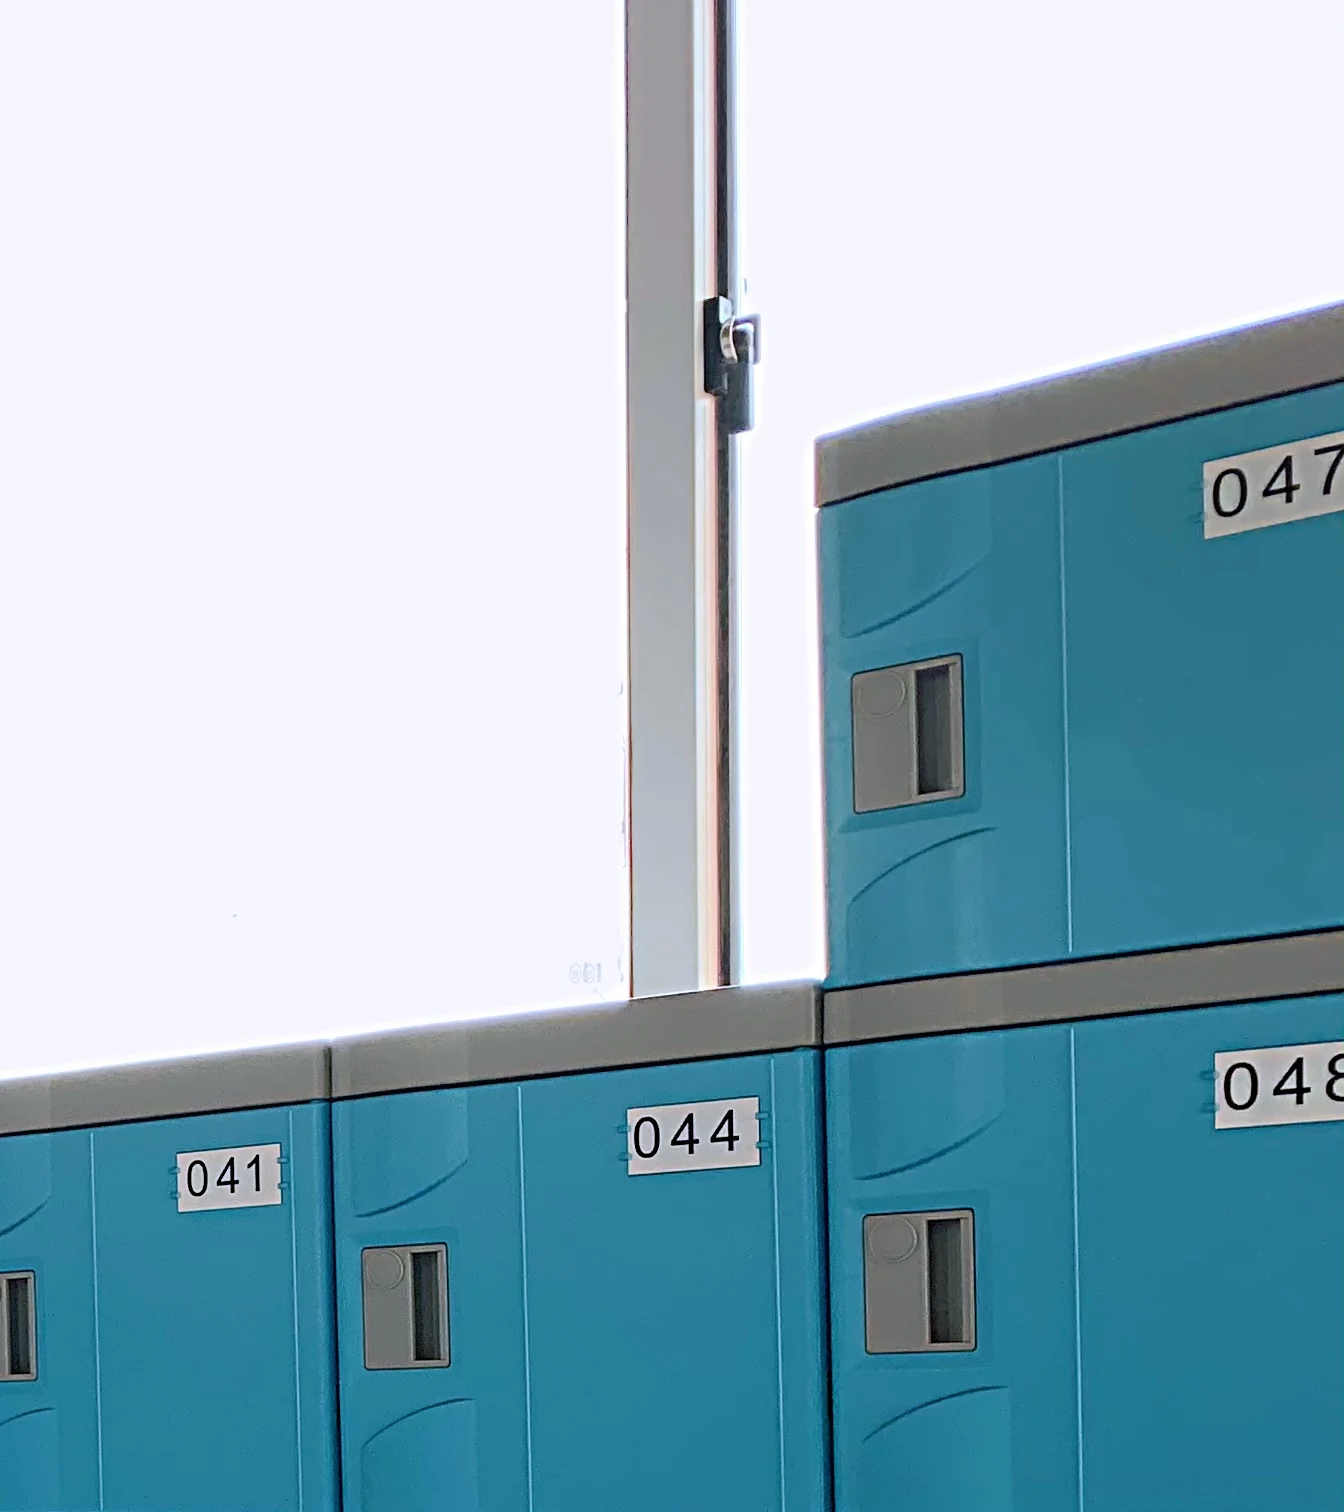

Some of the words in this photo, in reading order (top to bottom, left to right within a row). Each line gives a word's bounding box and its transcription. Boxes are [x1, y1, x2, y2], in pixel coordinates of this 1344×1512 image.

[1213, 444, 1344, 517] 047
[634, 1110, 739, 1158] 044
[188, 1154, 260, 1196] 041
